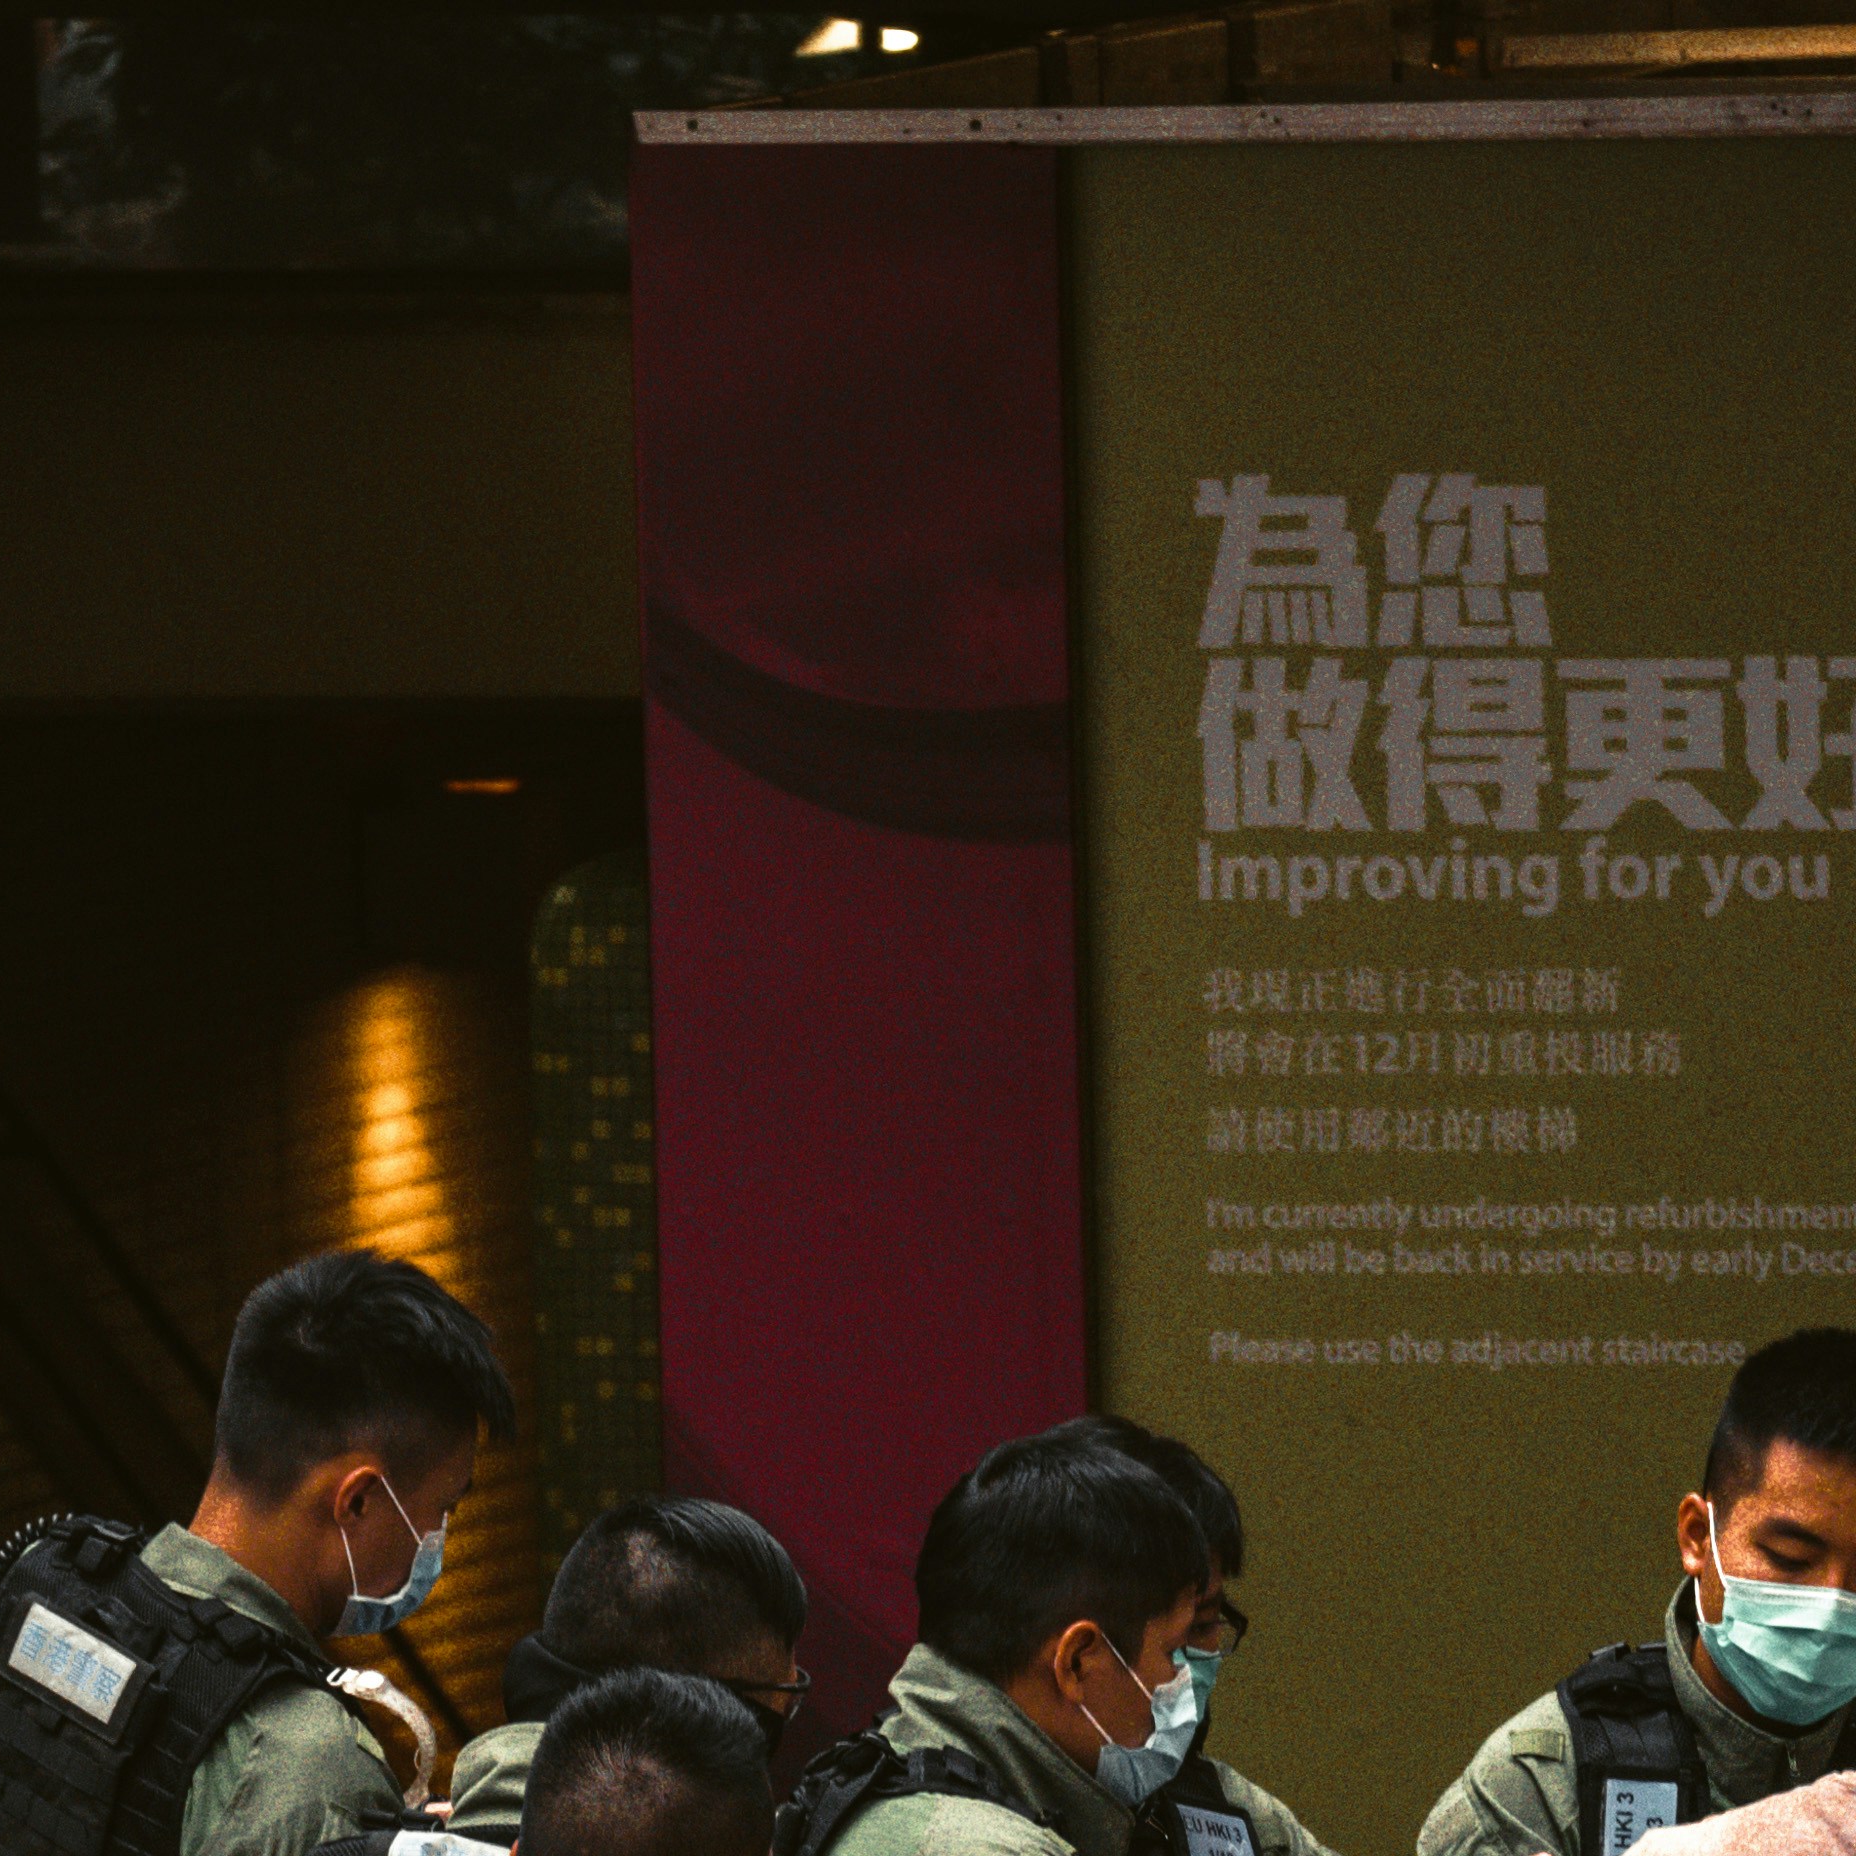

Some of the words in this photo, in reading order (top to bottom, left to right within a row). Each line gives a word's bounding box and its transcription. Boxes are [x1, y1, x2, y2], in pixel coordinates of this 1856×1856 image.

[1194, 473, 1553, 648] 為您
[1197, 837, 1561, 918] Improving
[1578, 836, 1682, 901] for
[1698, 854, 1830, 918] you
[1206, 1197, 1256, 1230] I'm
[1262, 1195, 1412, 1237] currently
[1418, 1196, 1617, 1238] undergoing
[1207, 1241, 1272, 1274] and
[1278, 1240, 1337, 1274] will
[1343, 1241, 1387, 1275] be
[1392, 1241, 1473, 1275] back
[1479, 1242, 1512, 1273] in
[1519, 1242, 1634, 1275] service
[1641, 1242, 1683, 1283] by
[1690, 1241, 1774, 1283] early
[1209, 1330, 1316, 1364] Please
[1322, 1338, 1381, 1365] use
[1387, 1330, 1445, 1365] the
[1450, 1331, 1593, 1372] adjacent
[1601, 1332, 1745, 1366] staircase
[1205, 1820, 1232, 1842] HKI
